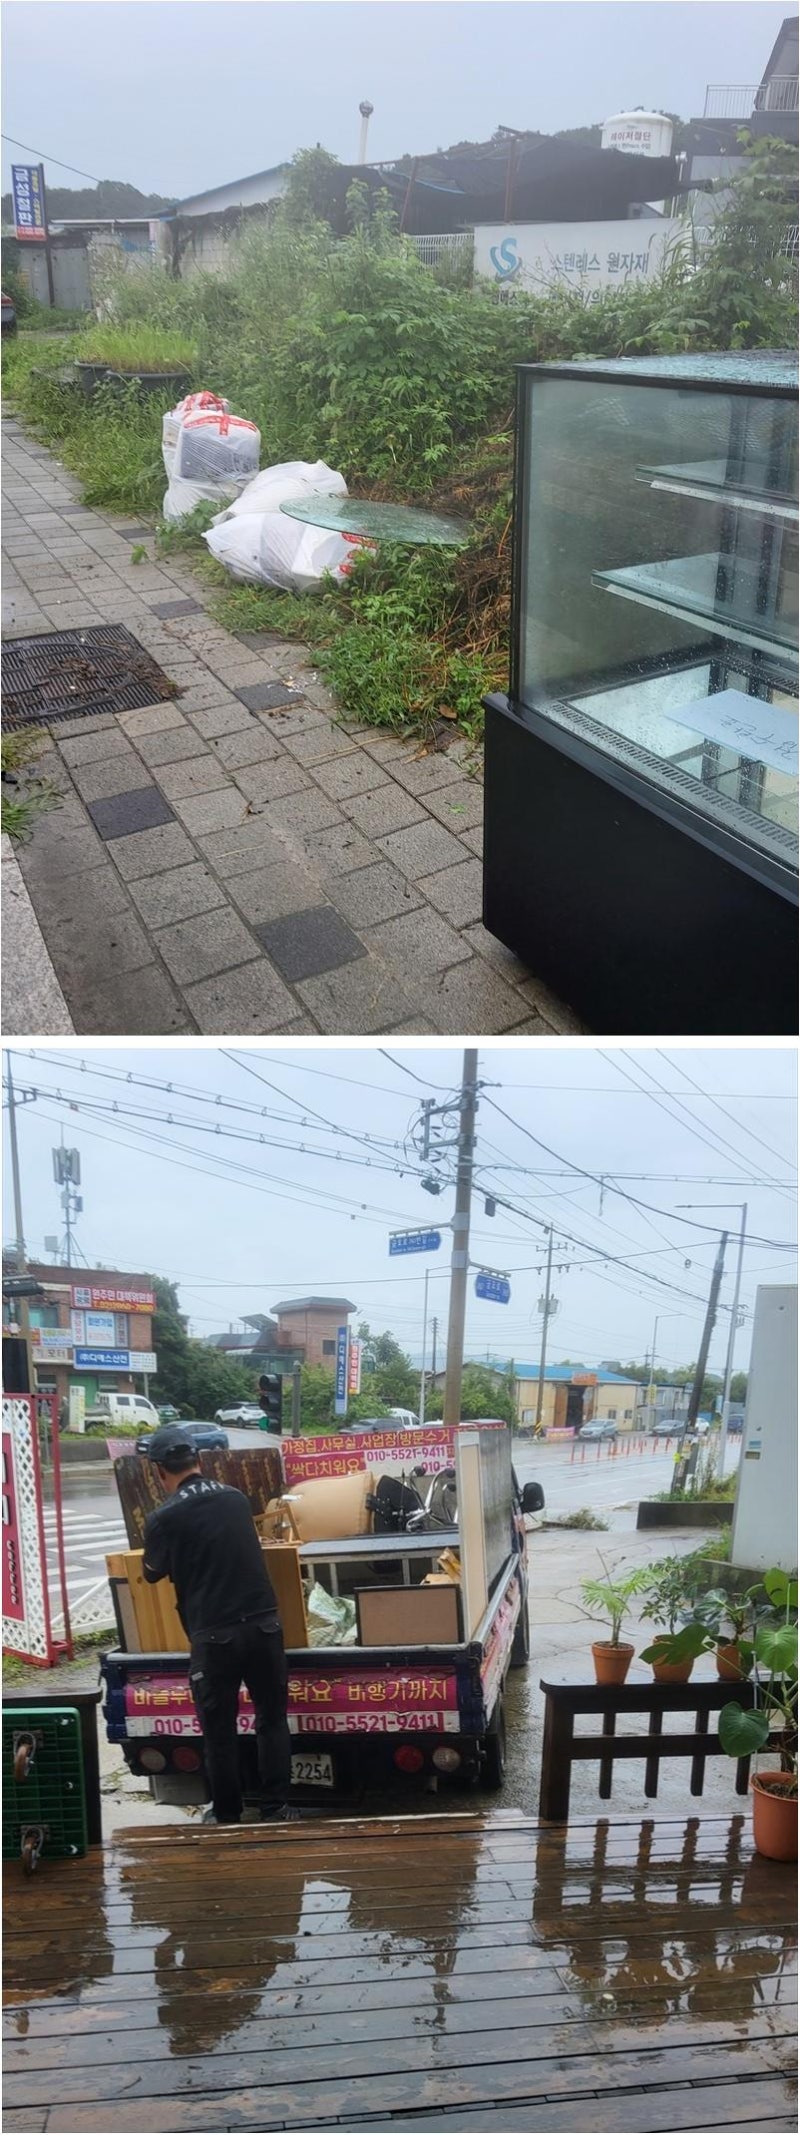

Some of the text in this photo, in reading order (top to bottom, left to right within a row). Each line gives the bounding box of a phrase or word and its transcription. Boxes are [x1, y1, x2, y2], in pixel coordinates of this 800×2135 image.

[607, 251, 649, 273] 원자재
[367, 1446, 445, 1462] 010-5521-9411
[348, 1679, 448, 1702] 비행기까지
[306, 1714, 434, 1732] 010-5521-9411
